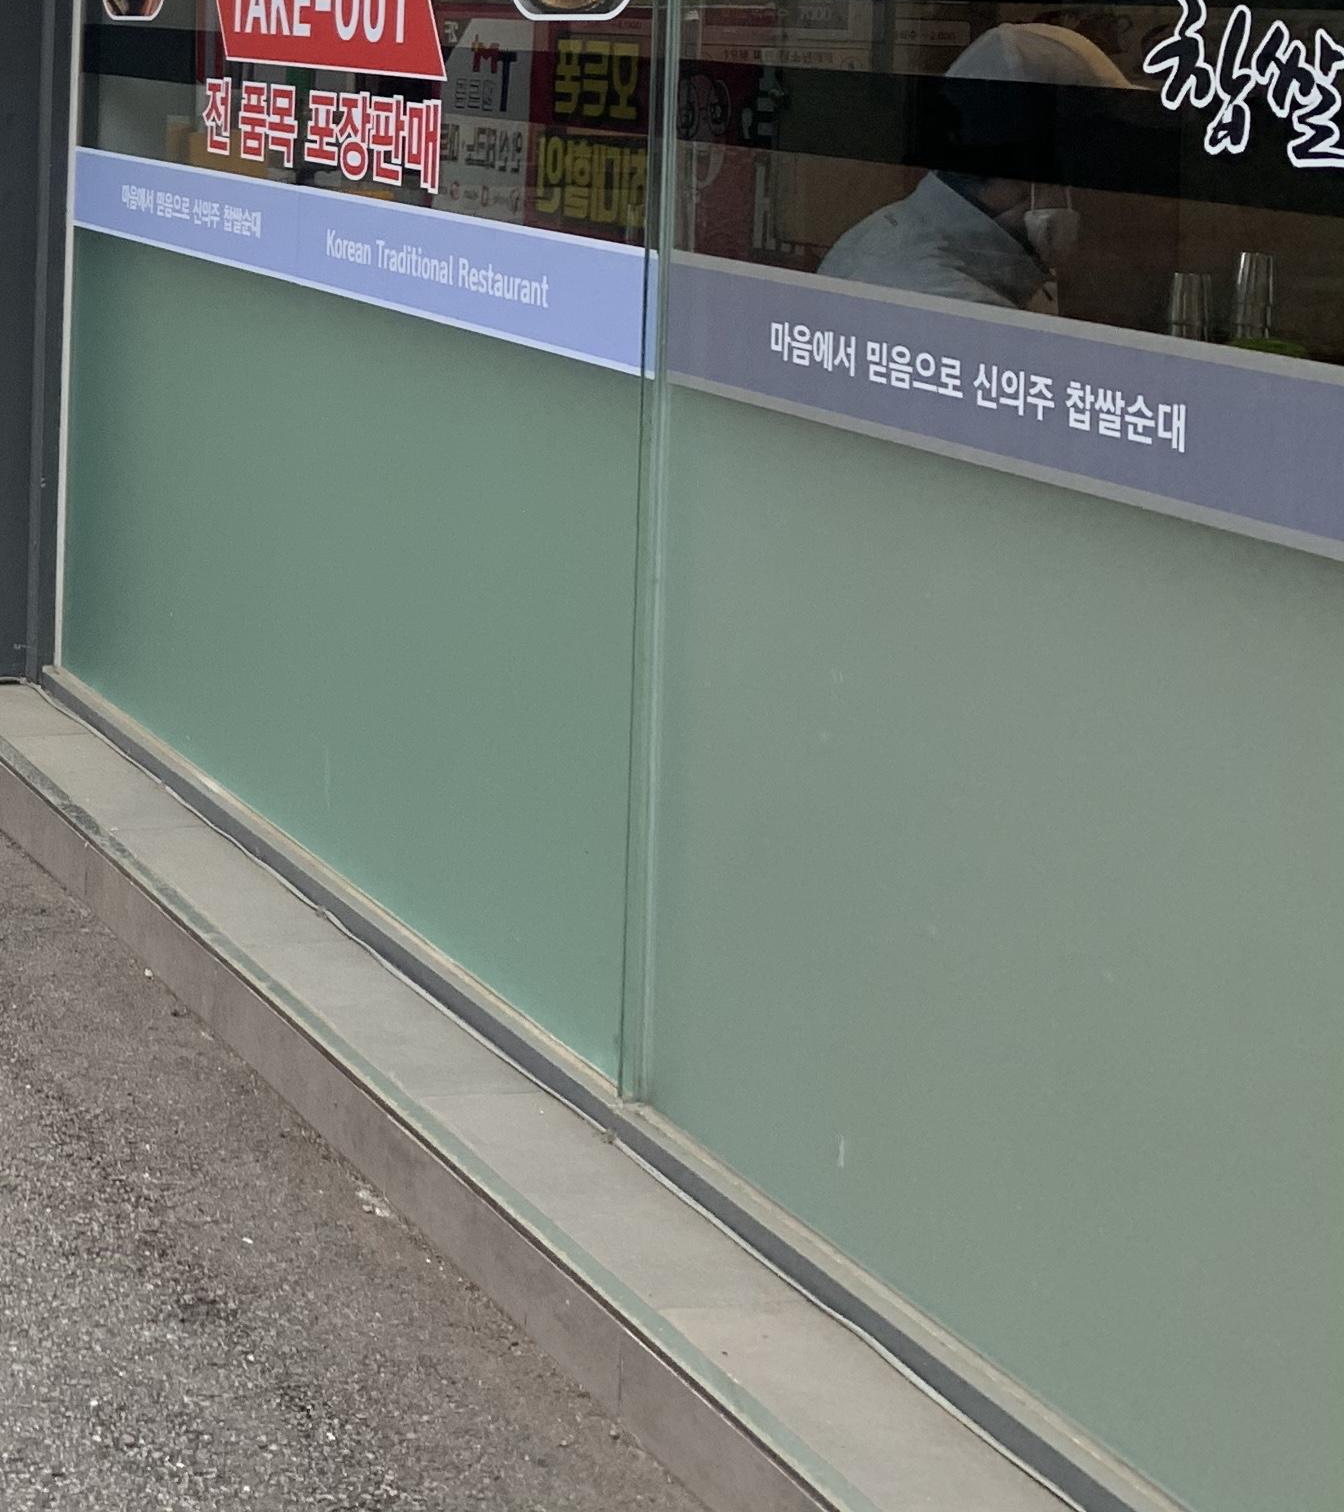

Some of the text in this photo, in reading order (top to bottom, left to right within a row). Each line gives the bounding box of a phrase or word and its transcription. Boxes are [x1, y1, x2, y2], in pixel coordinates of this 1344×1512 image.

[203, 76, 442, 194] 전 품목 포장판매
[121, 184, 154, 216] 마음에서
[192, 200, 221, 230] 신의주
[325, 230, 549, 308] Korean Traditional Restaurant
[770, 321, 1187, 454] 마음에서 믿음으로 신의주 찹쌀순대
